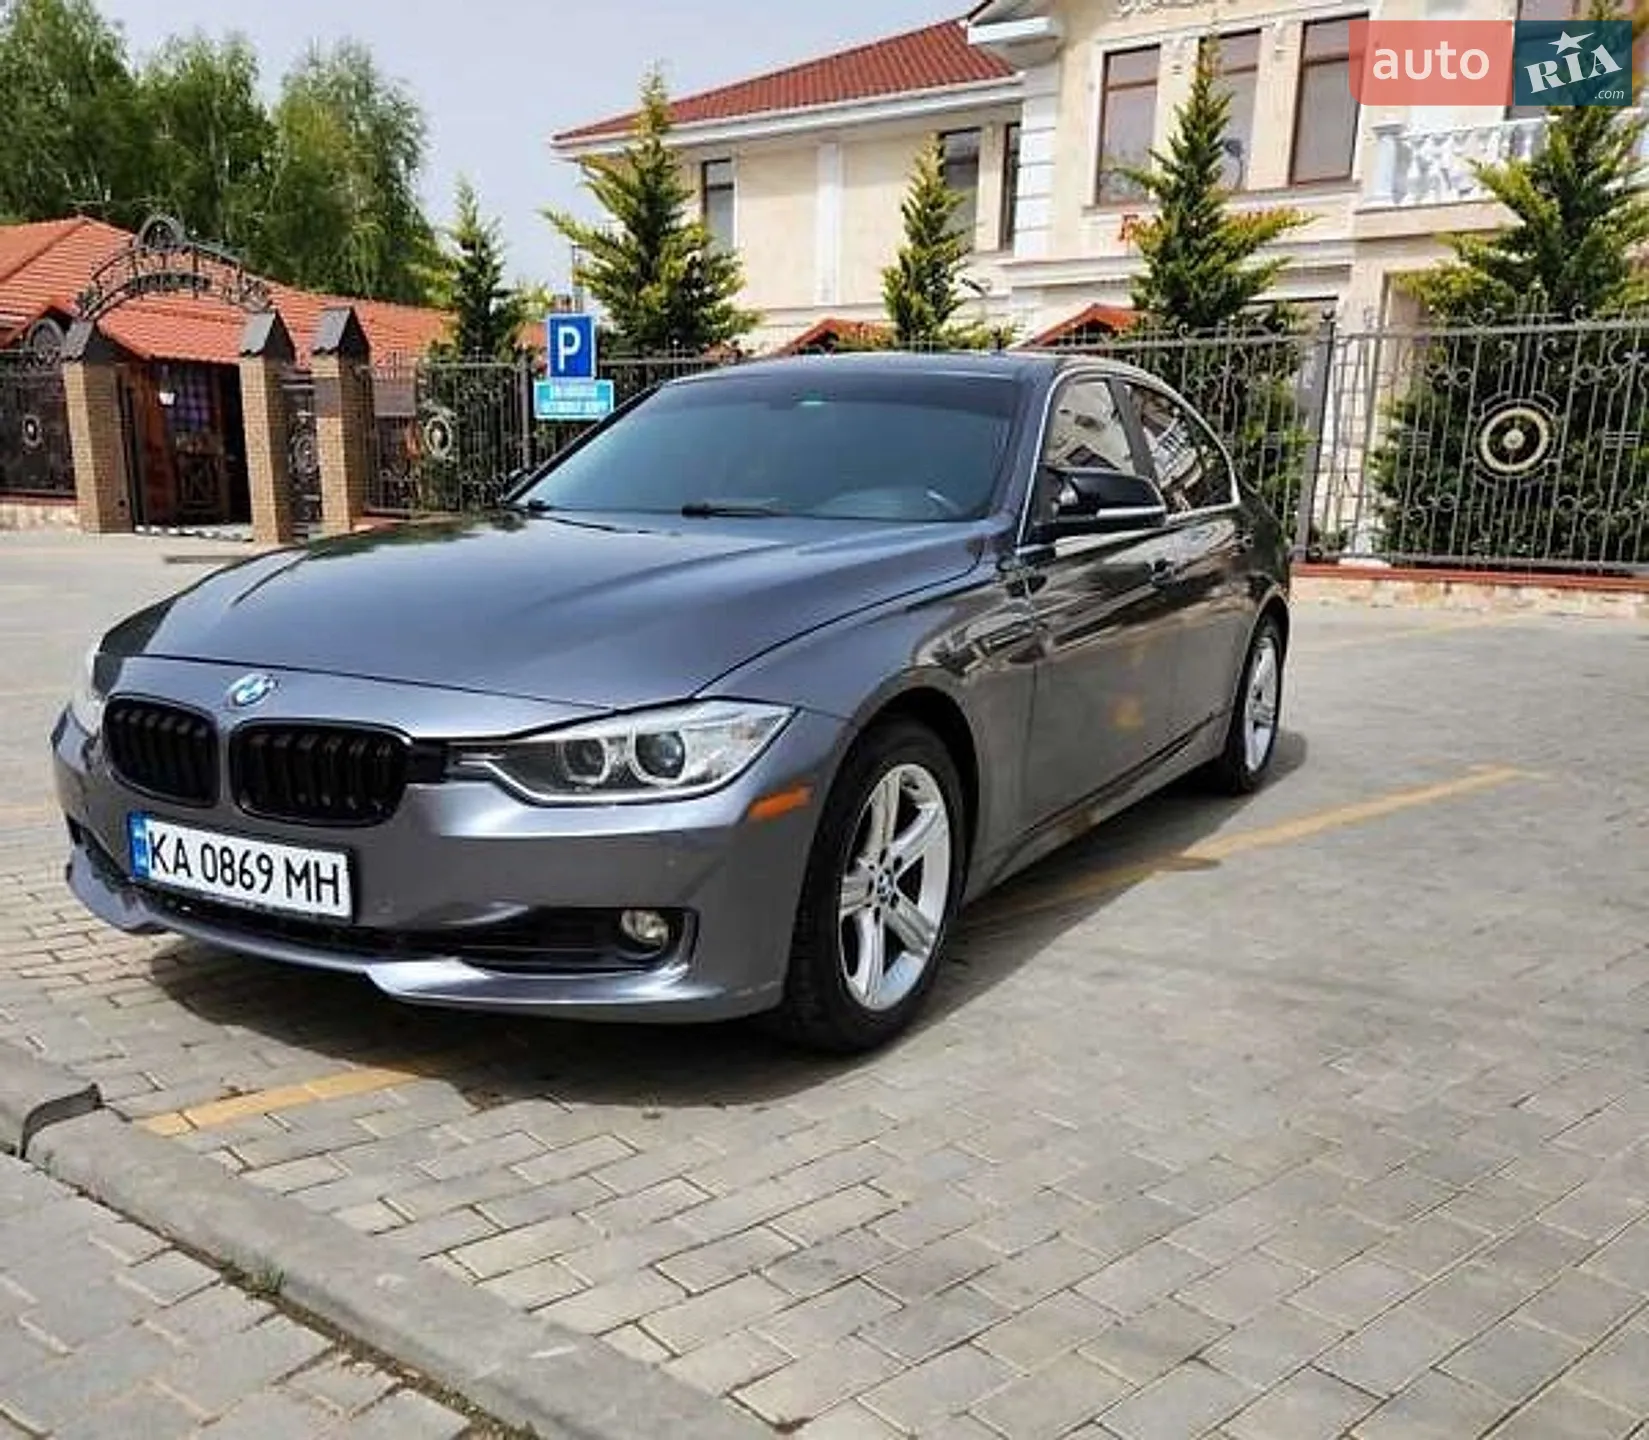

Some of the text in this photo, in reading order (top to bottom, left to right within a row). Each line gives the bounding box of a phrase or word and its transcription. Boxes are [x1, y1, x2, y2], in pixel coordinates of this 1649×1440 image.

[558, 326, 581, 372] P
[148, 832, 340, 905] KA 0869 MH
